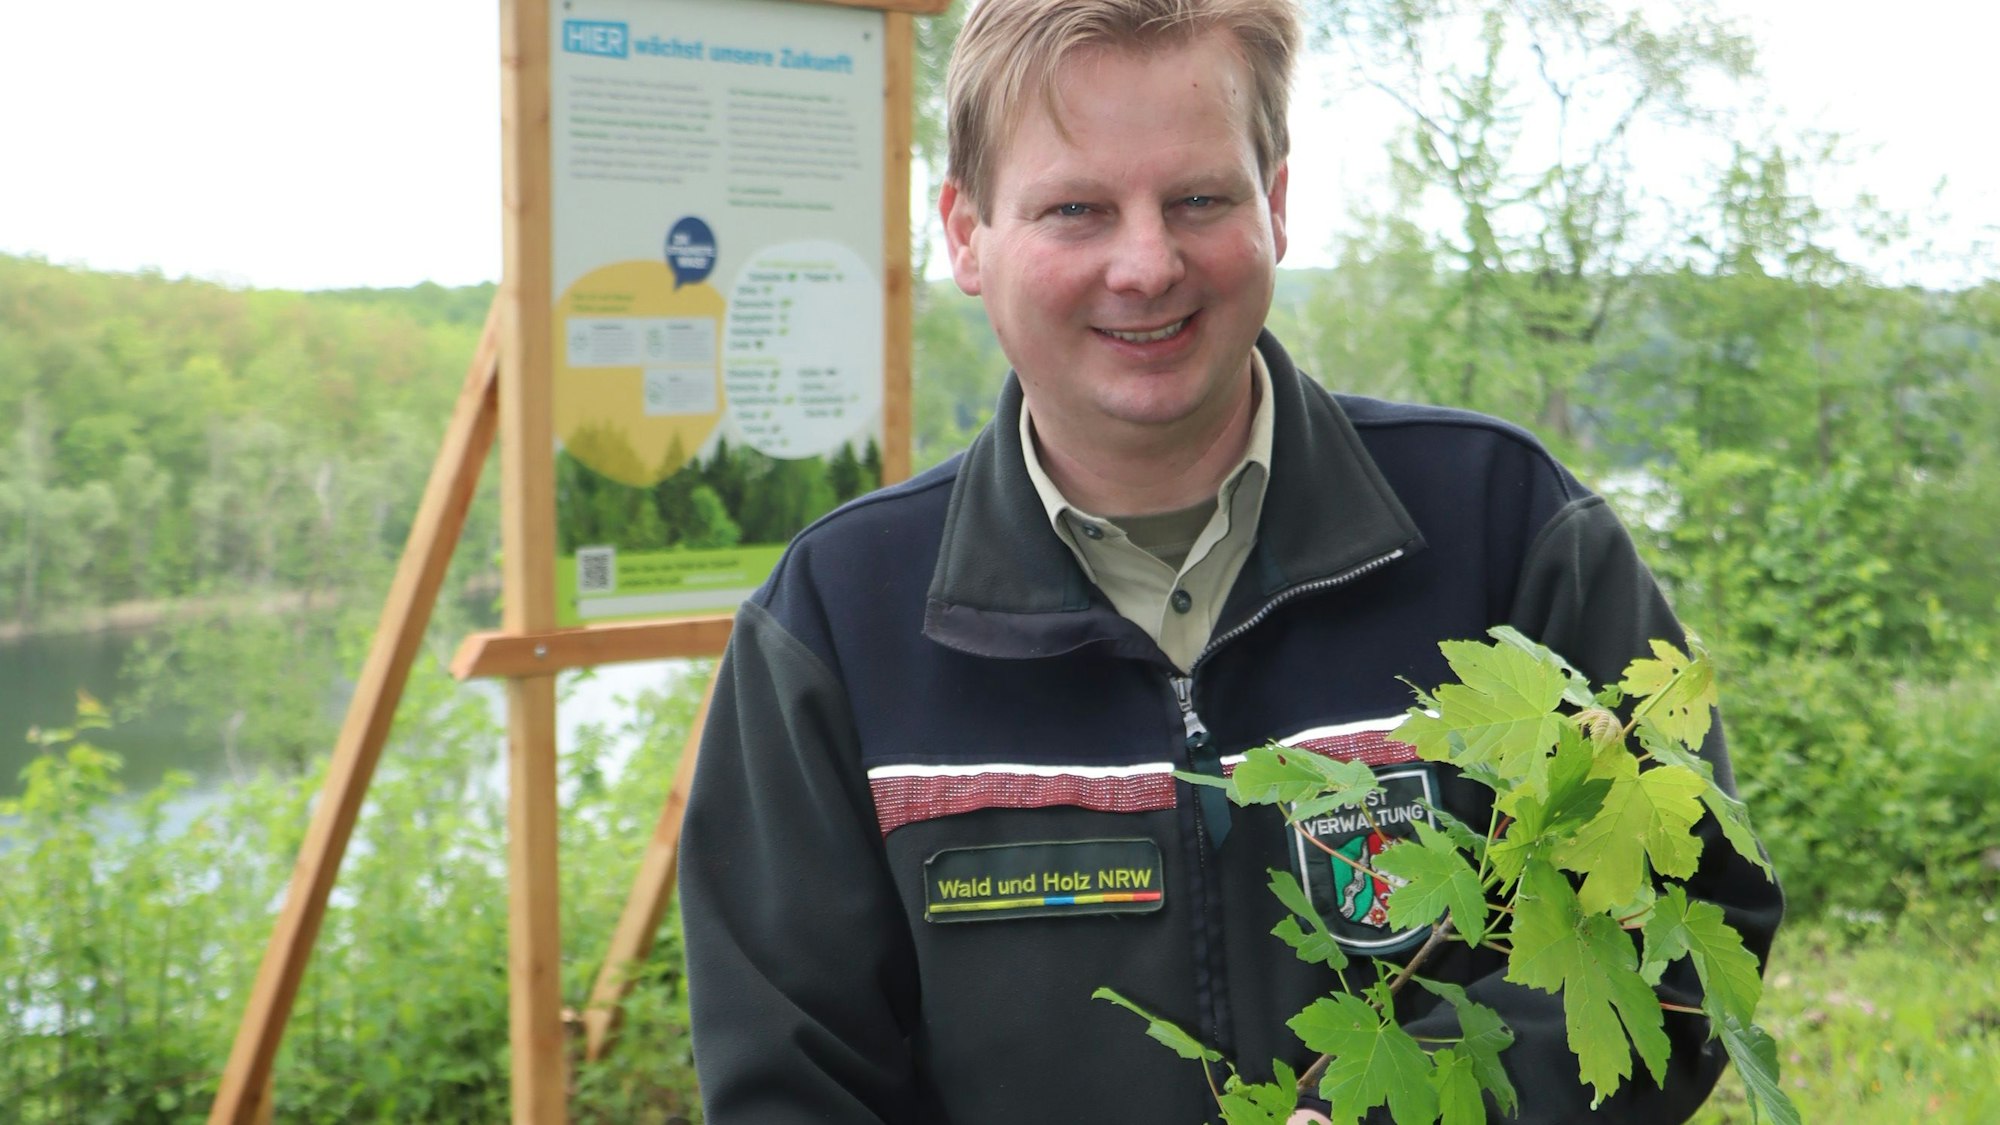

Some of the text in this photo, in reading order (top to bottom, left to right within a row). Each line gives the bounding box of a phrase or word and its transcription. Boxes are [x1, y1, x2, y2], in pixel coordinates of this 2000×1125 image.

[568, 26, 853, 73] HIER wächst unsere Zukunft
[938, 869, 1152, 899] Wald und Holz NRW
